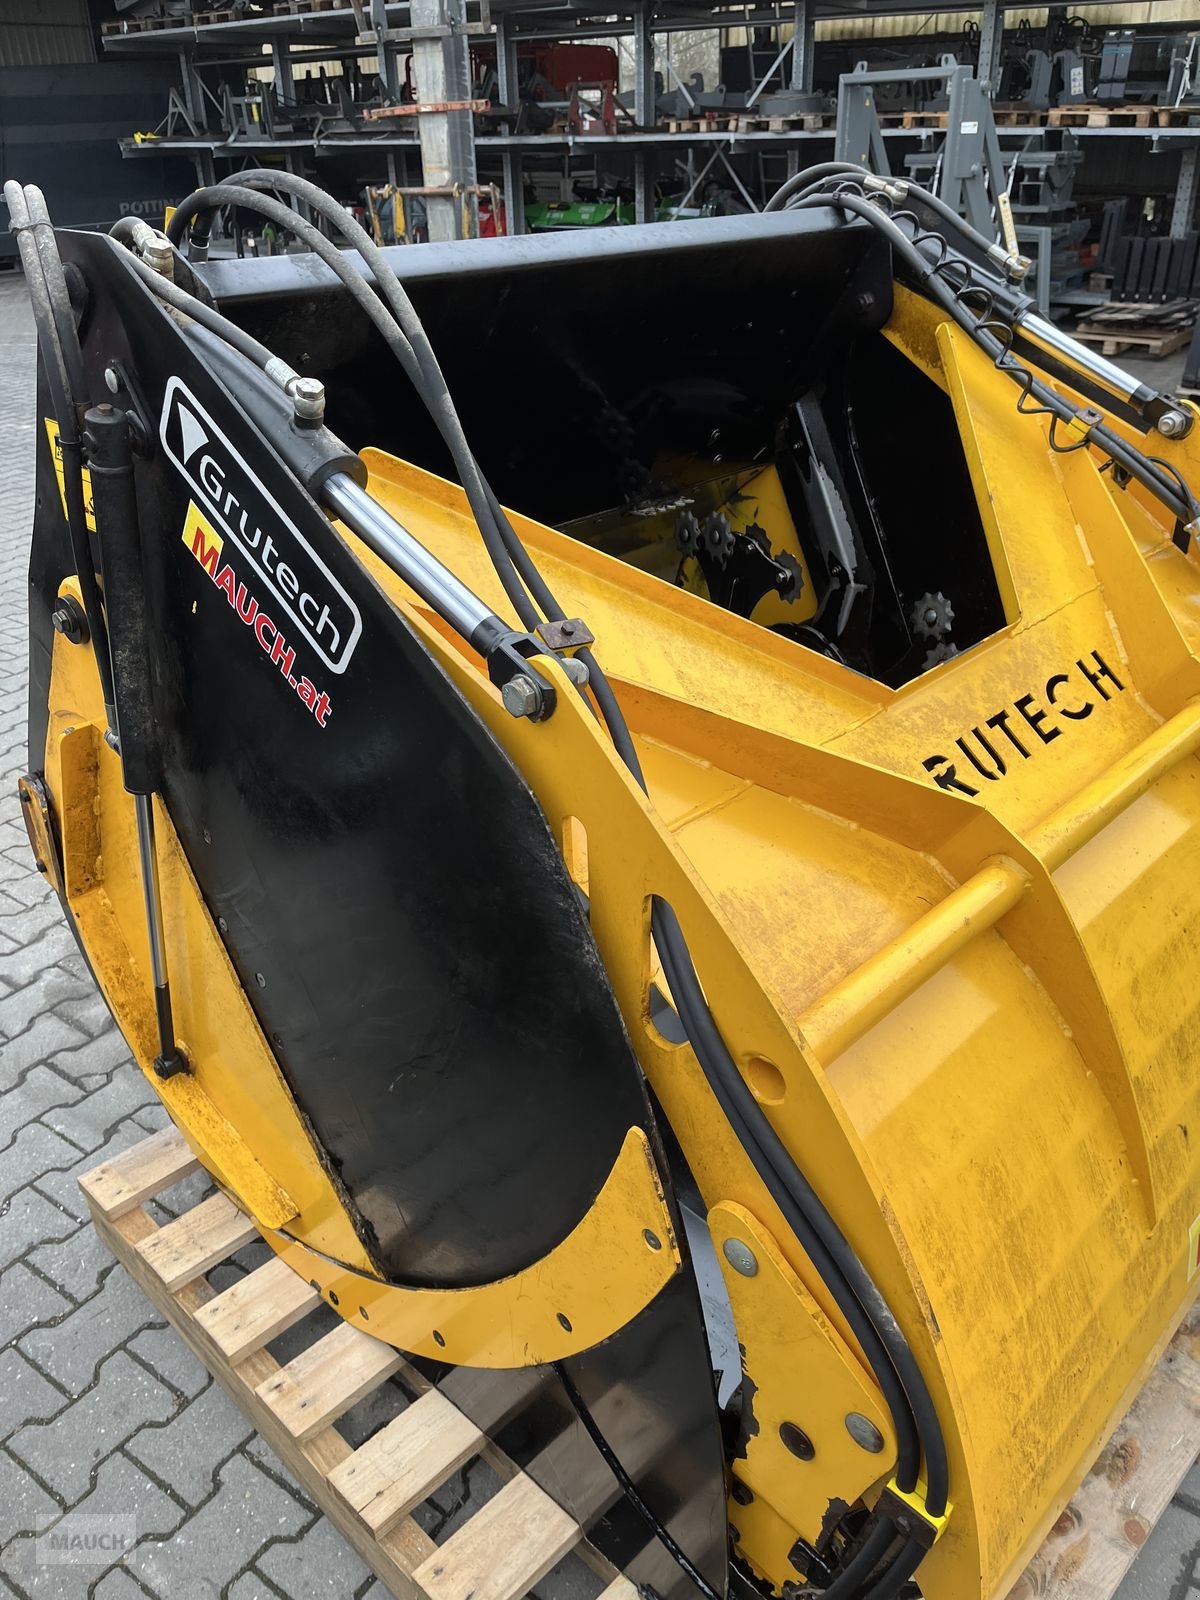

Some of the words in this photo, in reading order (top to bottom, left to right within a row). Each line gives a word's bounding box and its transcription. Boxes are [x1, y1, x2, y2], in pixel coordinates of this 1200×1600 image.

[191, 526, 332, 728] MAUCH.at
[200, 455, 340, 653] Grutech
[922, 650, 1125, 797] RUTECH
